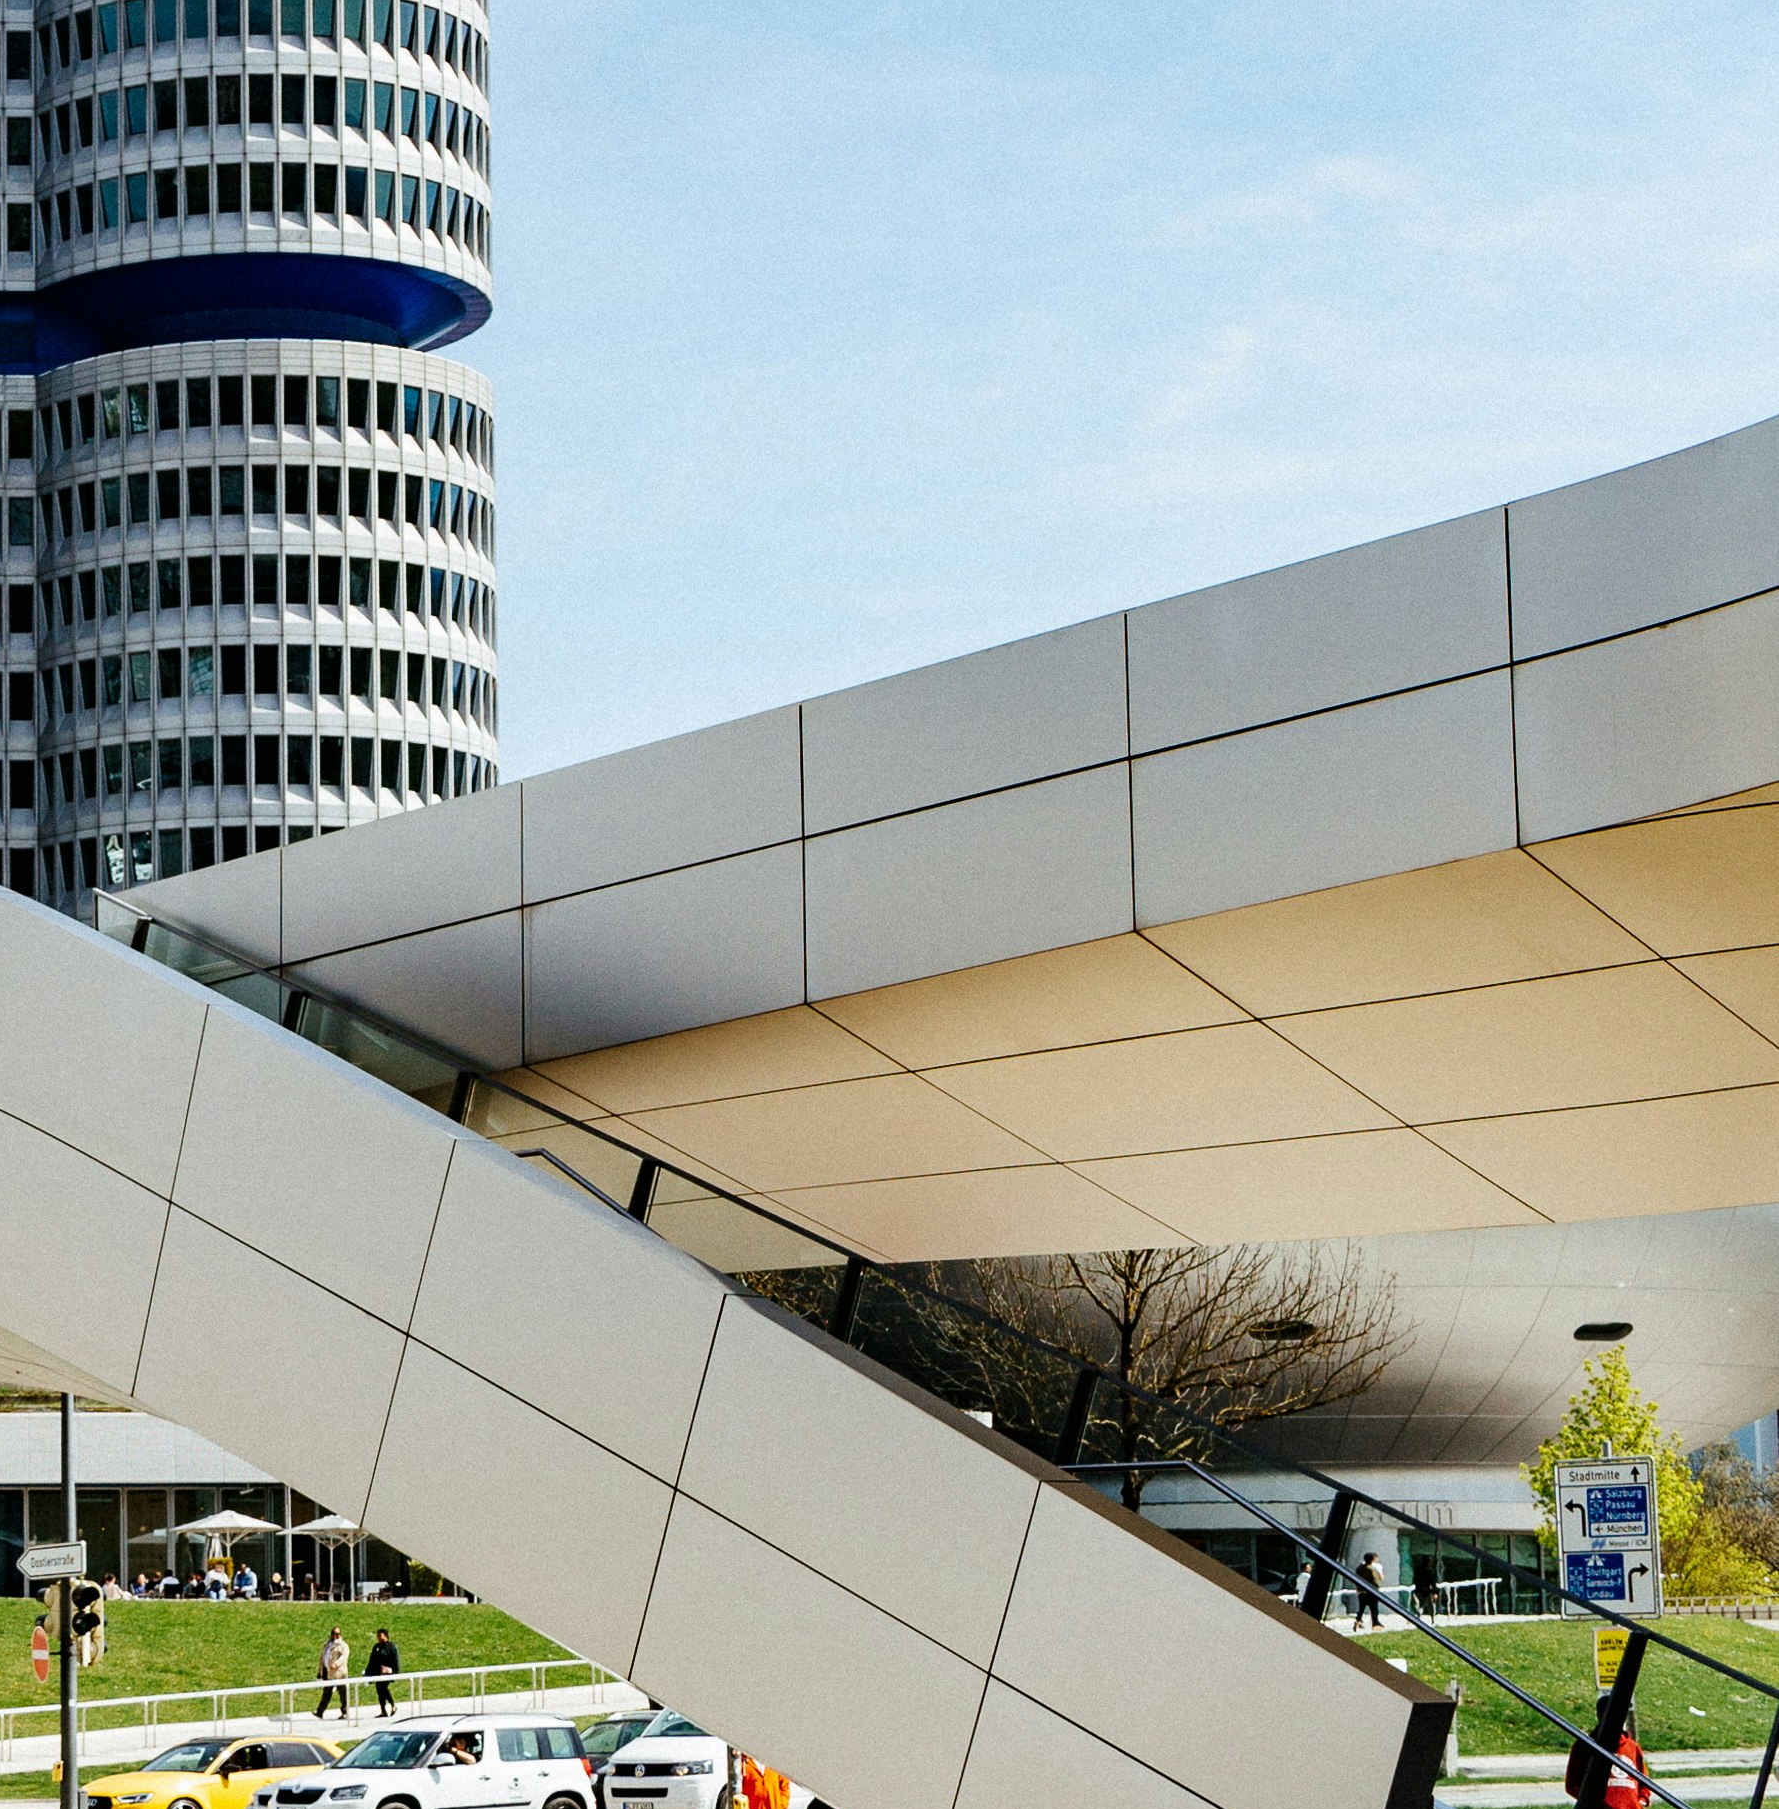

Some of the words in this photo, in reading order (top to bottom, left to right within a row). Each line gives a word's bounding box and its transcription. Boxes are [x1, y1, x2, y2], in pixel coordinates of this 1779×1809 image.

[1569, 1471, 1620, 1482] Stadtmitte
[1605, 1489, 1642, 1499] Salzburg
[1605, 1500, 1636, 1510] Passau
[1586, 1567, 1622, 1578] Stuttgart
[1586, 1589, 1615, 1599] Lindau
